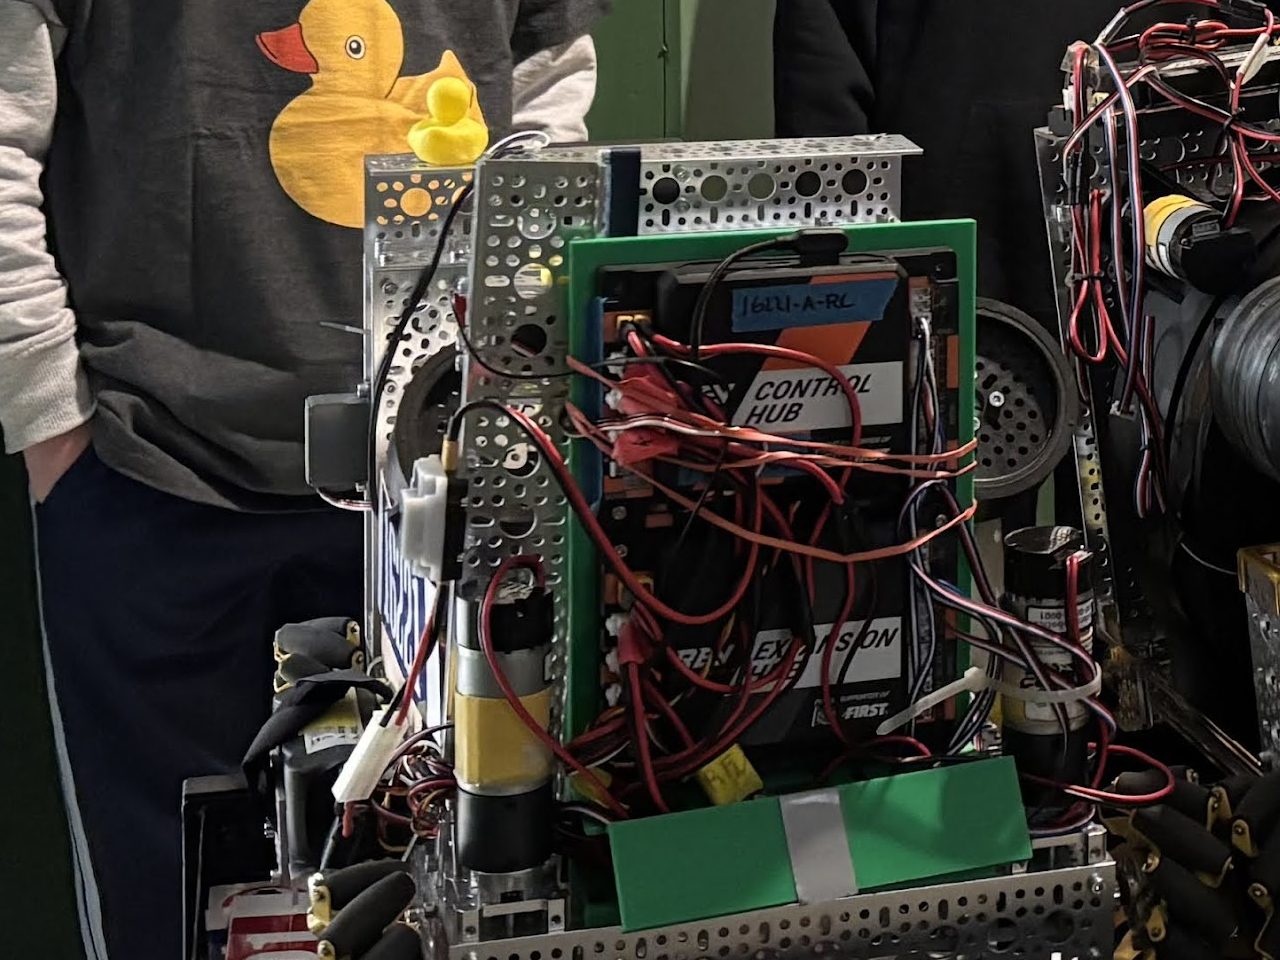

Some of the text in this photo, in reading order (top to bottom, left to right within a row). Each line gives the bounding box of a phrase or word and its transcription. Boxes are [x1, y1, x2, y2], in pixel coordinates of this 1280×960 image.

[755, 373, 872, 401] CONTROL
[745, 403, 804, 425] HUB
[844, 702, 890, 720] FIRST
